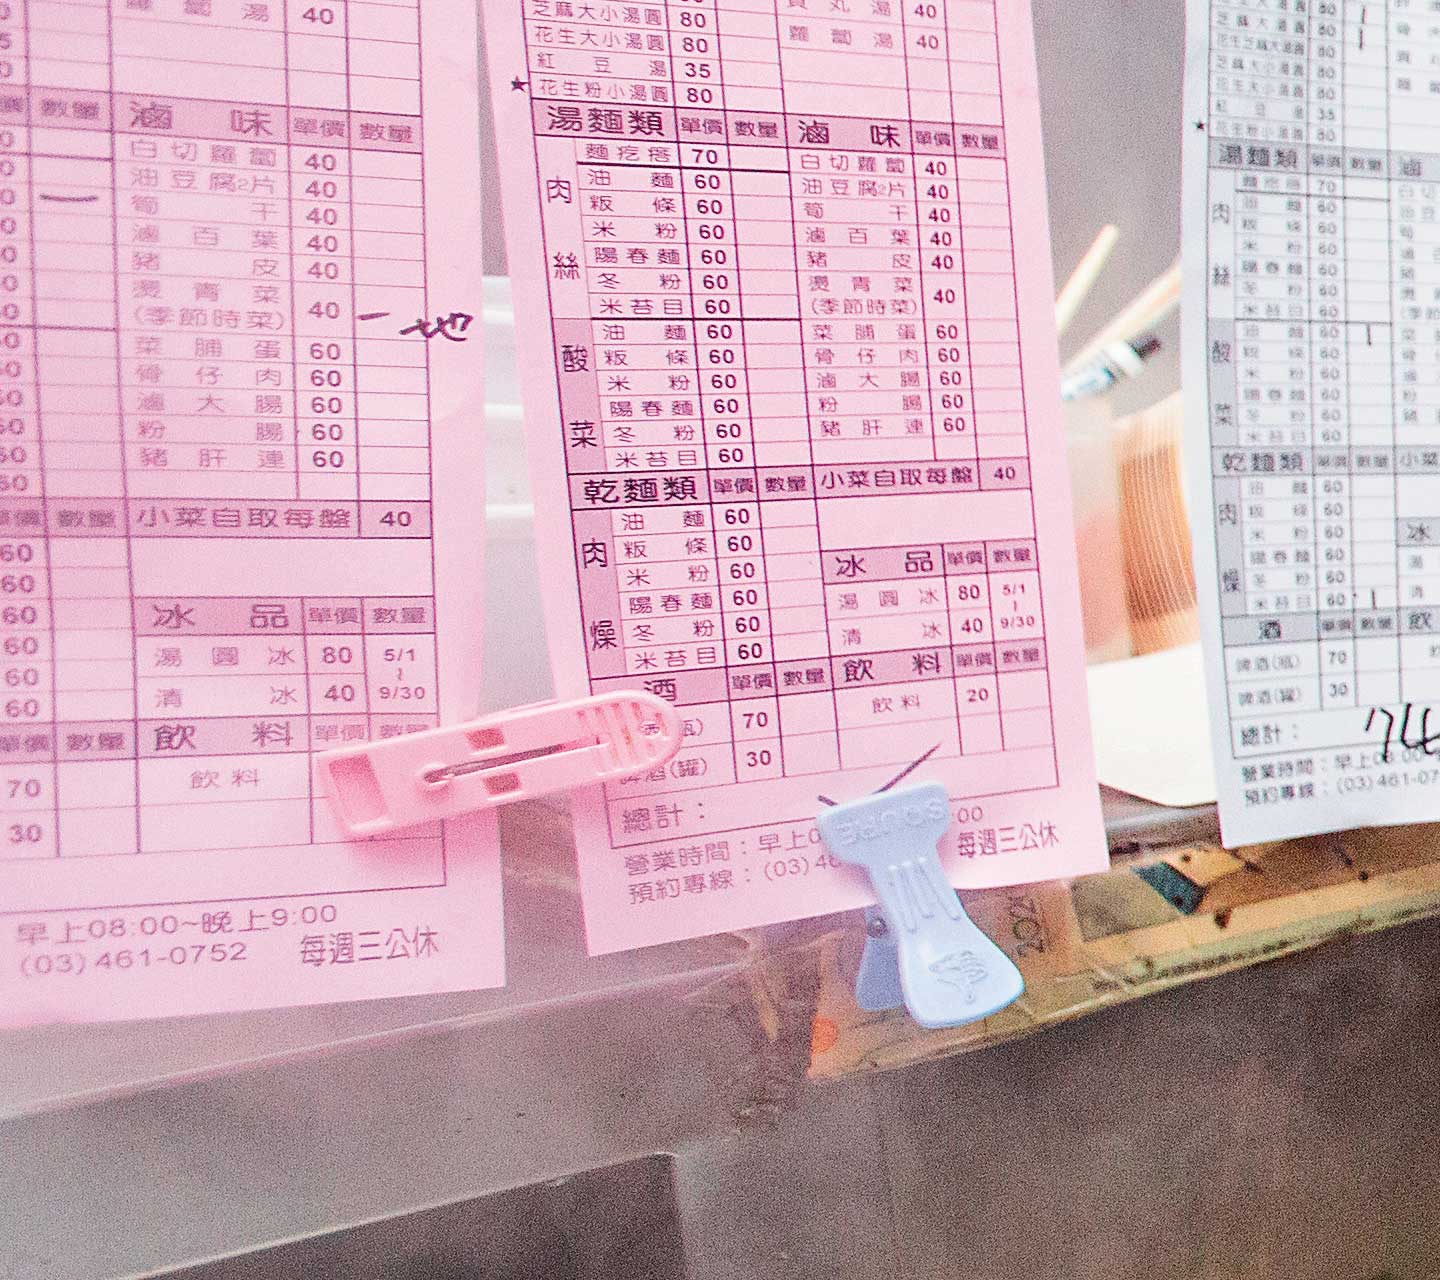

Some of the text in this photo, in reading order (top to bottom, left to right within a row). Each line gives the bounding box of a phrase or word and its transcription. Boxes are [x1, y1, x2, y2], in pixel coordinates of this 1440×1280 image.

[302, 7, 334, 25] 40
[680, 12, 706, 28] 80
[682, 37, 708, 53] 80
[685, 62, 711, 79] 35
[687, 87, 713, 104] 80
[547, 105, 779, 138] 湯麵類 單價 數量
[305, 153, 337, 171] 40
[691, 149, 718, 165] 70
[925, 161, 947, 176] 40
[305, 180, 337, 199] 40
[694, 174, 721, 190] 60
[697, 199, 723, 215] 60
[928, 207, 951, 223] 40
[699, 224, 725, 240] 60
[701, 249, 727, 265] 60
[931, 254, 954, 270] 40
[703, 274, 729, 290] 60
[308, 301, 340, 320] 40
[705, 299, 730, 315] 60
[707, 324, 733, 340] 60
[935, 324, 958, 340] 60
[312, 451, 344, 468] 60
[821, 466, 1016, 489] 小菜自取每盤 40
[584, 475, 698, 505] 乾麵類
[138, 505, 412, 529] 小菜自取每盤 40
[725, 508, 750, 525] 60
[835, 551, 934, 578] 冰品
[732, 589, 757, 606] 60
[958, 585, 980, 600] 80
[153, 602, 289, 630] 冰品
[961, 615, 1035, 633] 40 9/30
[322, 646, 353, 664] 80
[383, 648, 416, 663] 5/1
[738, 642, 762, 660] 60
[1328, 651, 1347, 666] 70
[843, 651, 942, 682] 飲料
[324, 684, 425, 702] 40 9/30
[967, 687, 989, 704] 20
[1328, 683, 1348, 698] 30
[742, 711, 768, 729] 70
[154, 720, 293, 751] 飲料
[746, 750, 772, 767] 30
[7, 779, 41, 799] 70
[10, 824, 43, 843] 30
[958, 821, 1059, 859] 每週三公休
[300, 925, 440, 968] 每週三公休
